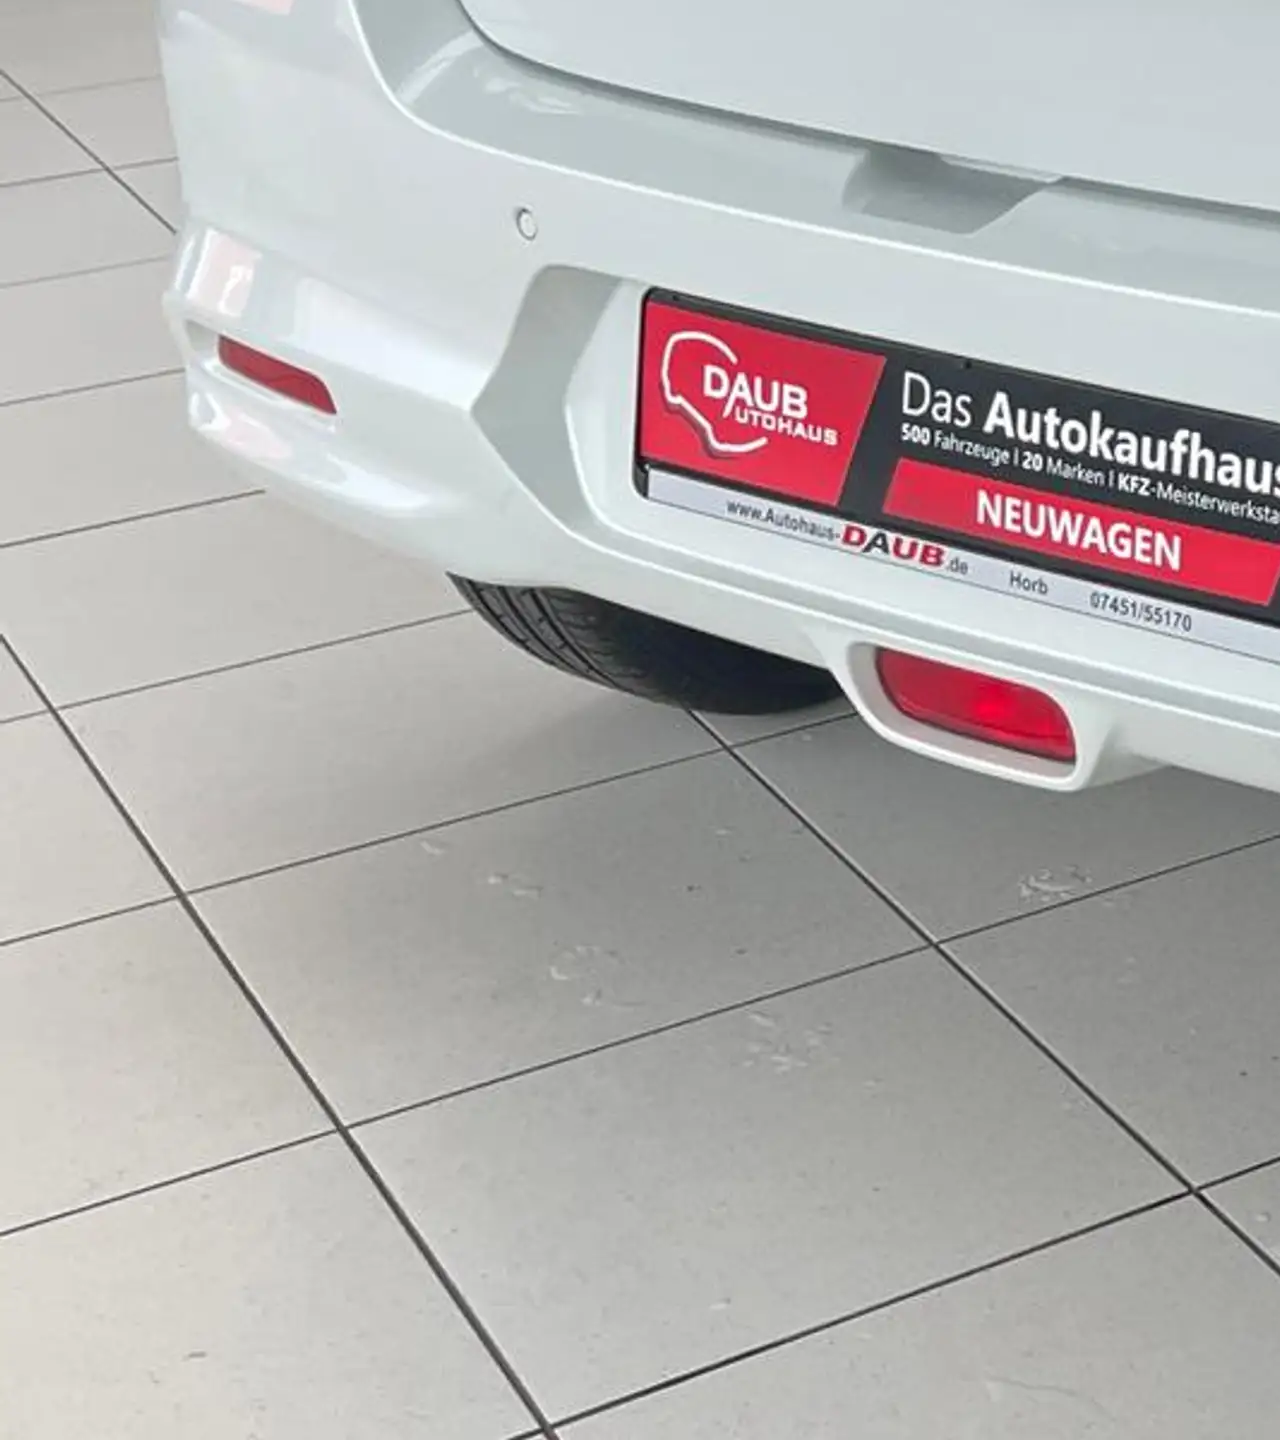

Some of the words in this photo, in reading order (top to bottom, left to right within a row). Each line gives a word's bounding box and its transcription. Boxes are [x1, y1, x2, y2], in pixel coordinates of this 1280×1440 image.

[702, 364, 809, 420] DAUB
[901, 369, 973, 428] Das
[901, 423, 931, 446] 500
[933, 429, 1010, 468] Fahrzeuge
[1022, 450, 1043, 472] 20
[1046, 458, 1105, 487] Marken
[976, 488, 1182, 572] NEUWAGEN
[725, 500, 969, 576] www.Autohaus-DAUB.de
[1009, 570, 1049, 596] Horb
[1089, 590, 1193, 633] 07451/55170
